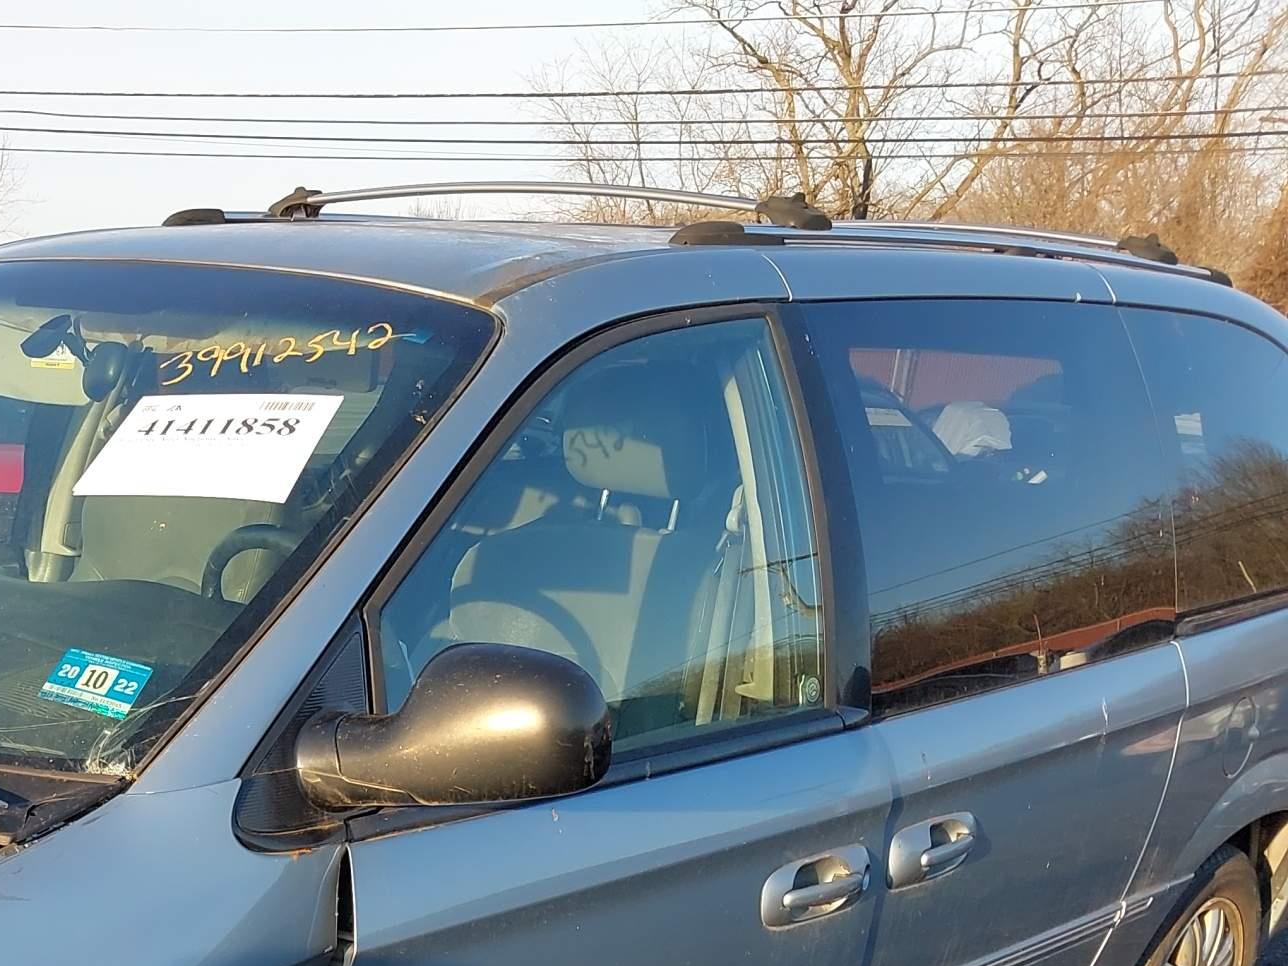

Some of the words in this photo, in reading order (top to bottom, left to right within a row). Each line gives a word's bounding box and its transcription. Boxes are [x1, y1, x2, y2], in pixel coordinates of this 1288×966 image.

[160, 322, 416, 386] 39912542
[137, 418, 300, 436] 41411858
[57, 663, 81, 679] 20
[81, 669, 109, 689] 10
[113, 678, 139, 695] 22
